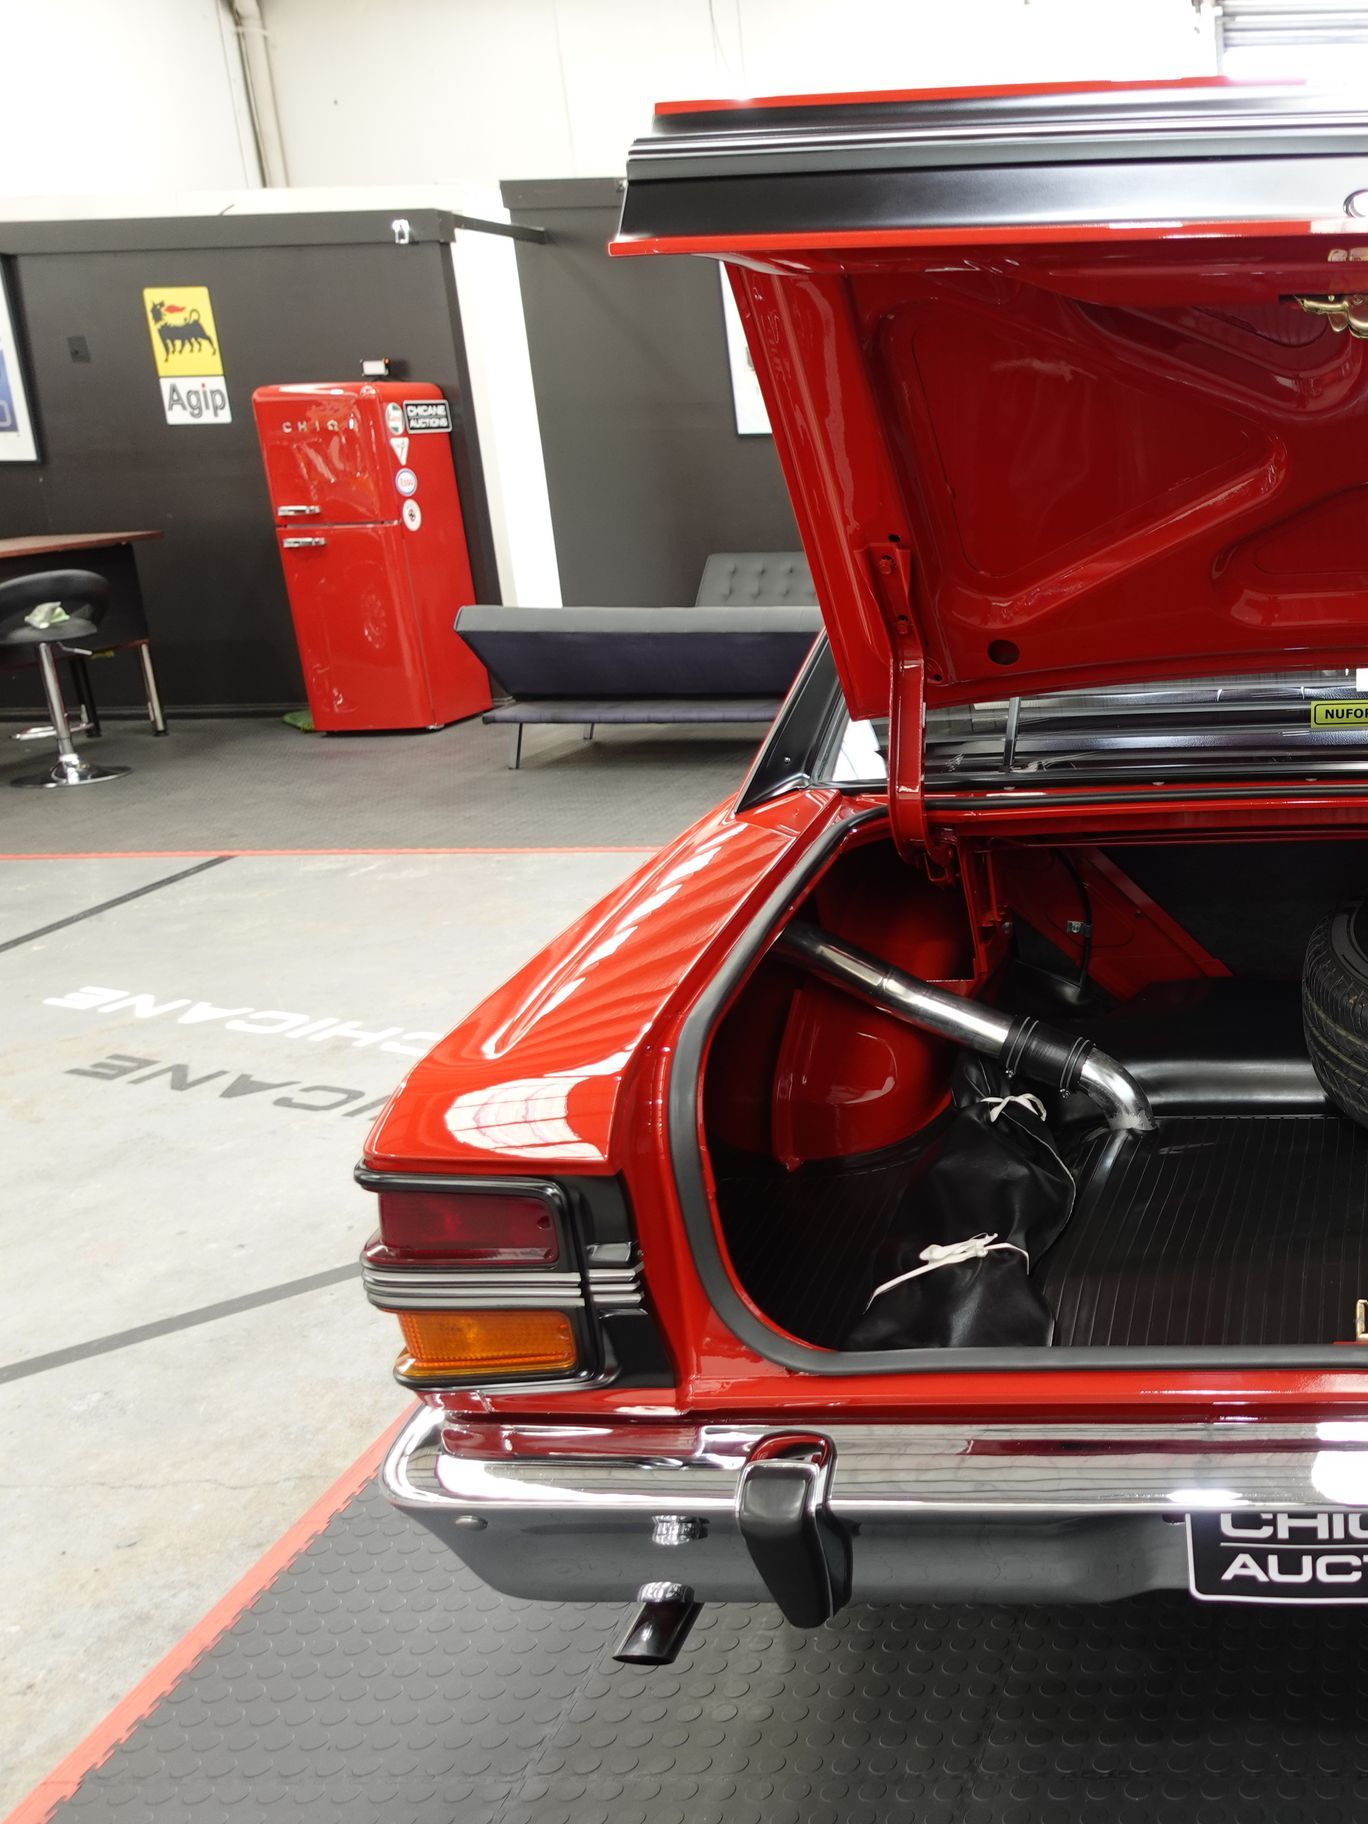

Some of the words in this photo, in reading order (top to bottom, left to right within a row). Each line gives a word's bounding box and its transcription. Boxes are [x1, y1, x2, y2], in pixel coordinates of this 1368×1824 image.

[167, 383, 226, 418] Agip
[407, 405, 446, 416] CHICANE
[410, 417, 448, 428] AUCTIONS
